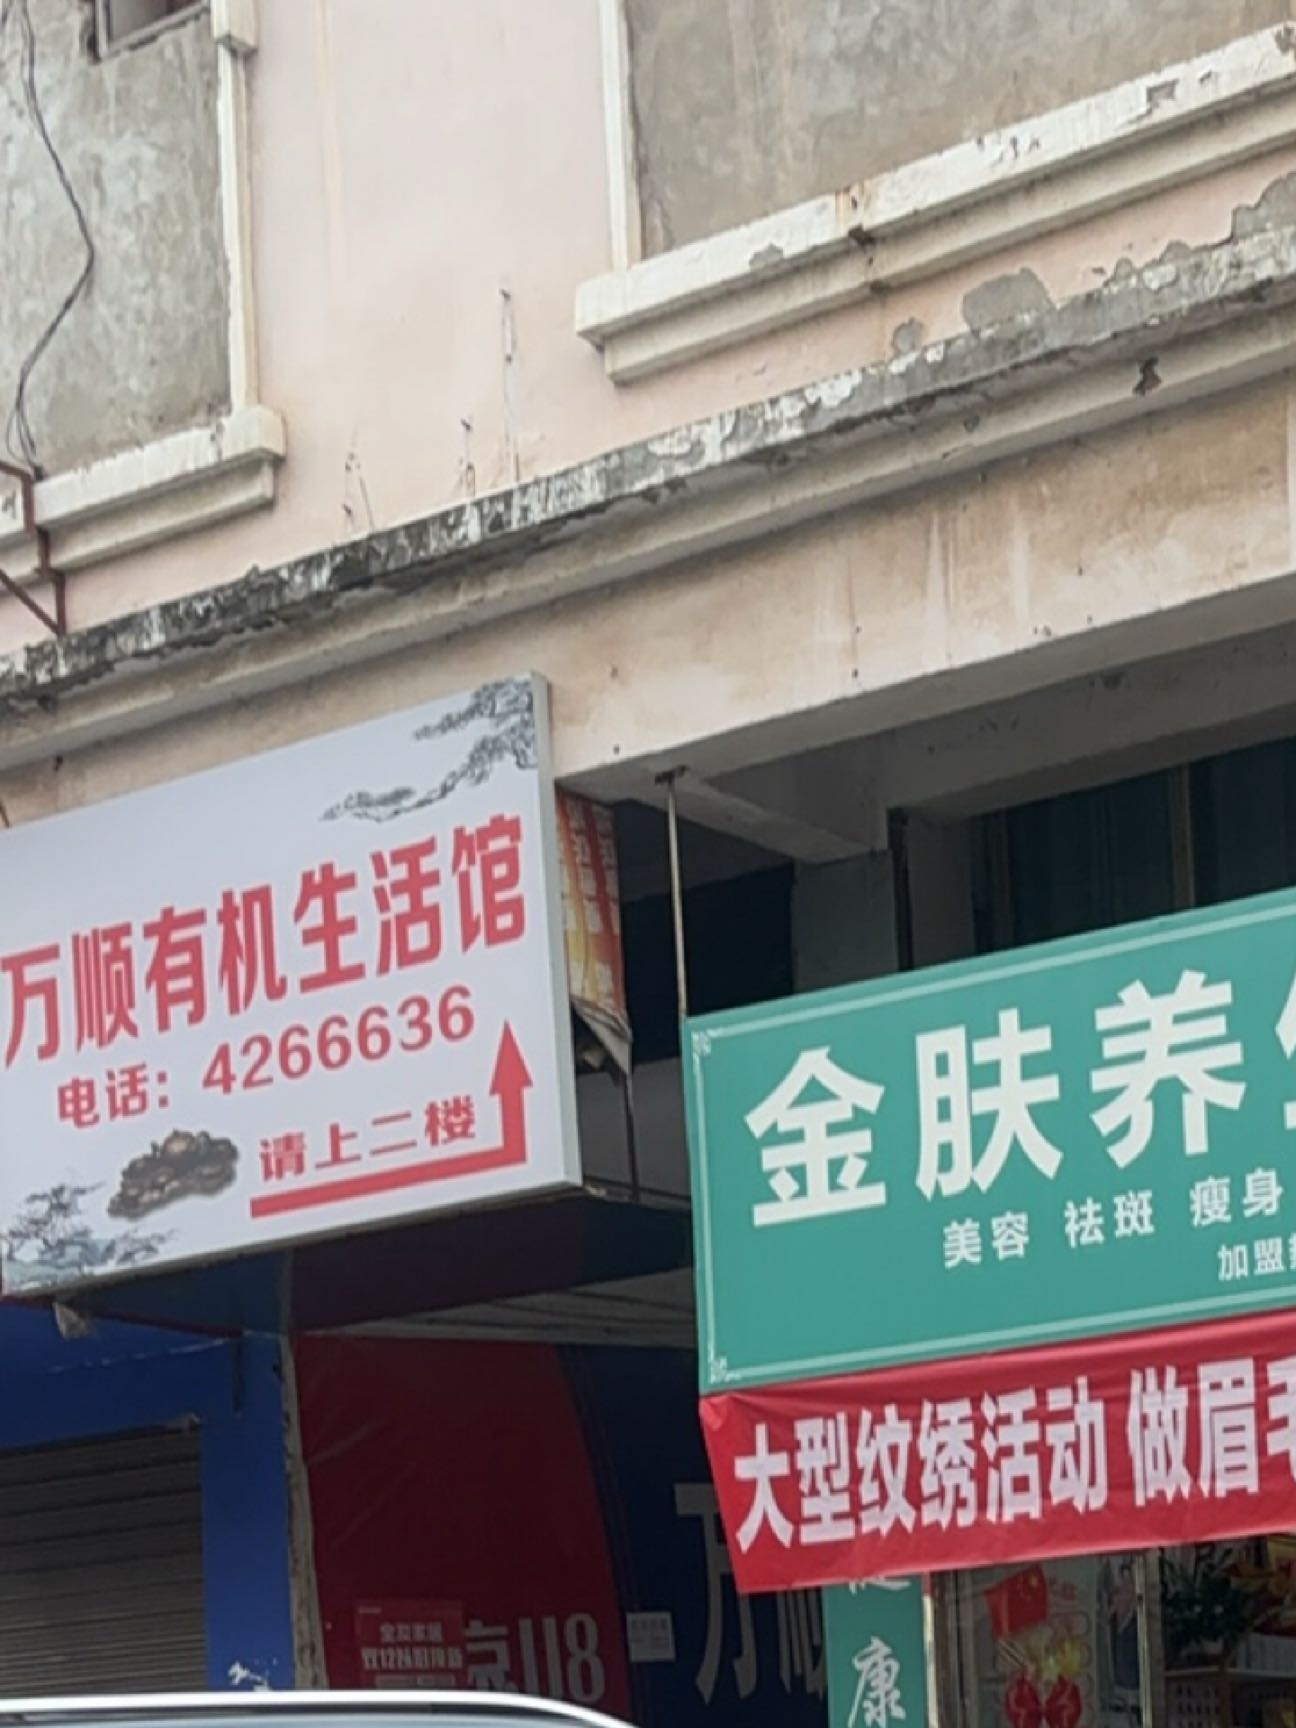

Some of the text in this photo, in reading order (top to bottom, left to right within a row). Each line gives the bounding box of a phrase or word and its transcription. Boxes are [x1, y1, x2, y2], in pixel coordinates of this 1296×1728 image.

[0, 813, 528, 1068] 万顺有机生活馆
[259, 1094, 477, 1182] 请上二楼
[943, 1209, 1031, 1269] 美容
[1064, 1189, 1156, 1249] 祛斑
[1190, 1166, 1284, 1227] 瘦身
[733, 1375, 1108, 1555] 大型纹绣活动
